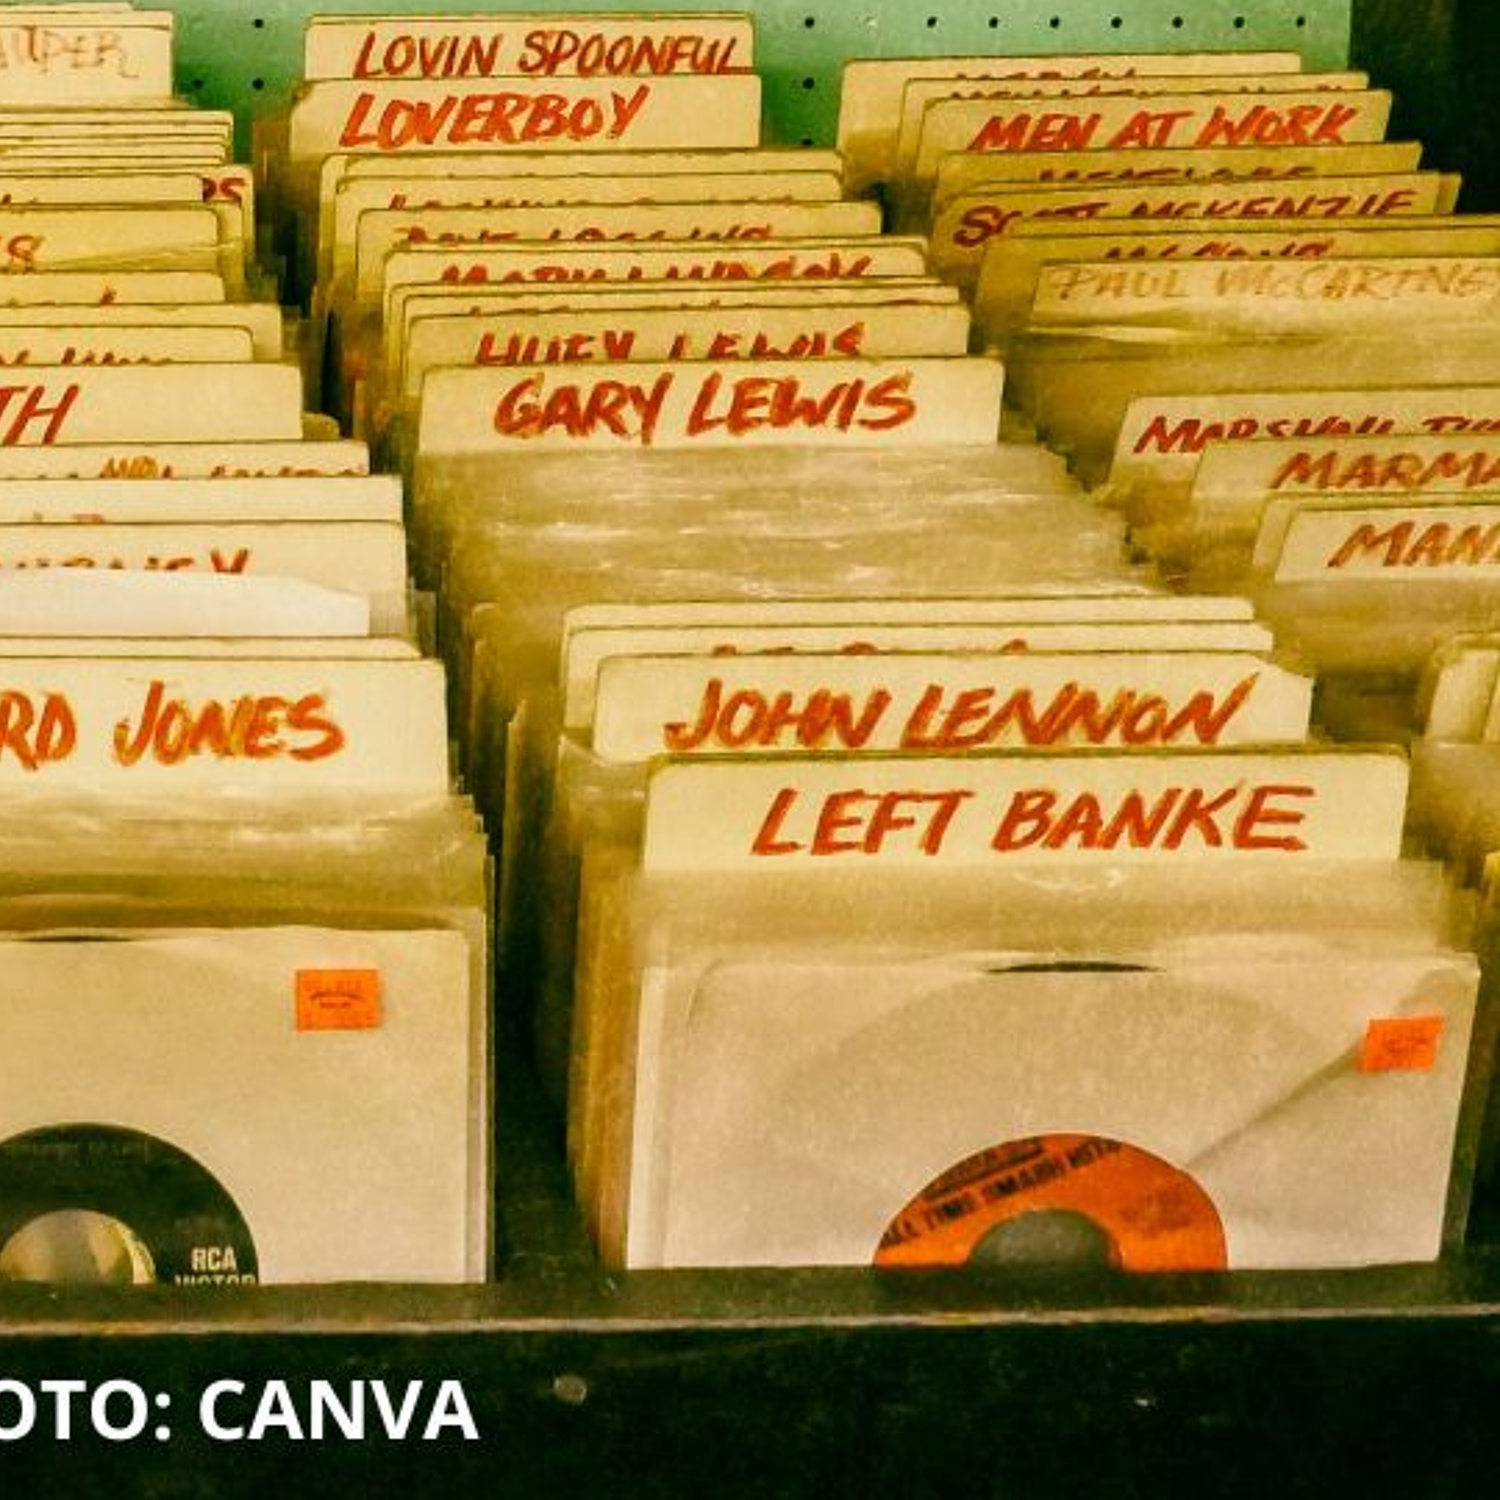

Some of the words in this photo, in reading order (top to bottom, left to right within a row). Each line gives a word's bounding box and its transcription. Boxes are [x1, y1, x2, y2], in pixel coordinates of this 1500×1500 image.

[354, 31, 503, 80] LOVIN
[517, 29, 754, 77] SPOONFUL
[338, 84, 652, 150] LOVERBOY
[966, 112, 1101, 151] MEN
[1106, 109, 1195, 149] AT
[1196, 103, 1359, 146] WORK
[492, 371, 674, 445] GARY
[686, 369, 920, 441] LEWIS
[114, 677, 346, 770] JONES
[663, 678, 895, 751] JOHN
[901, 671, 1261, 751] LENNON
[751, 787, 976, 856] LEFT
[991, 778, 1315, 853] BANKE
[190, 1246, 237, 1272] RCA
